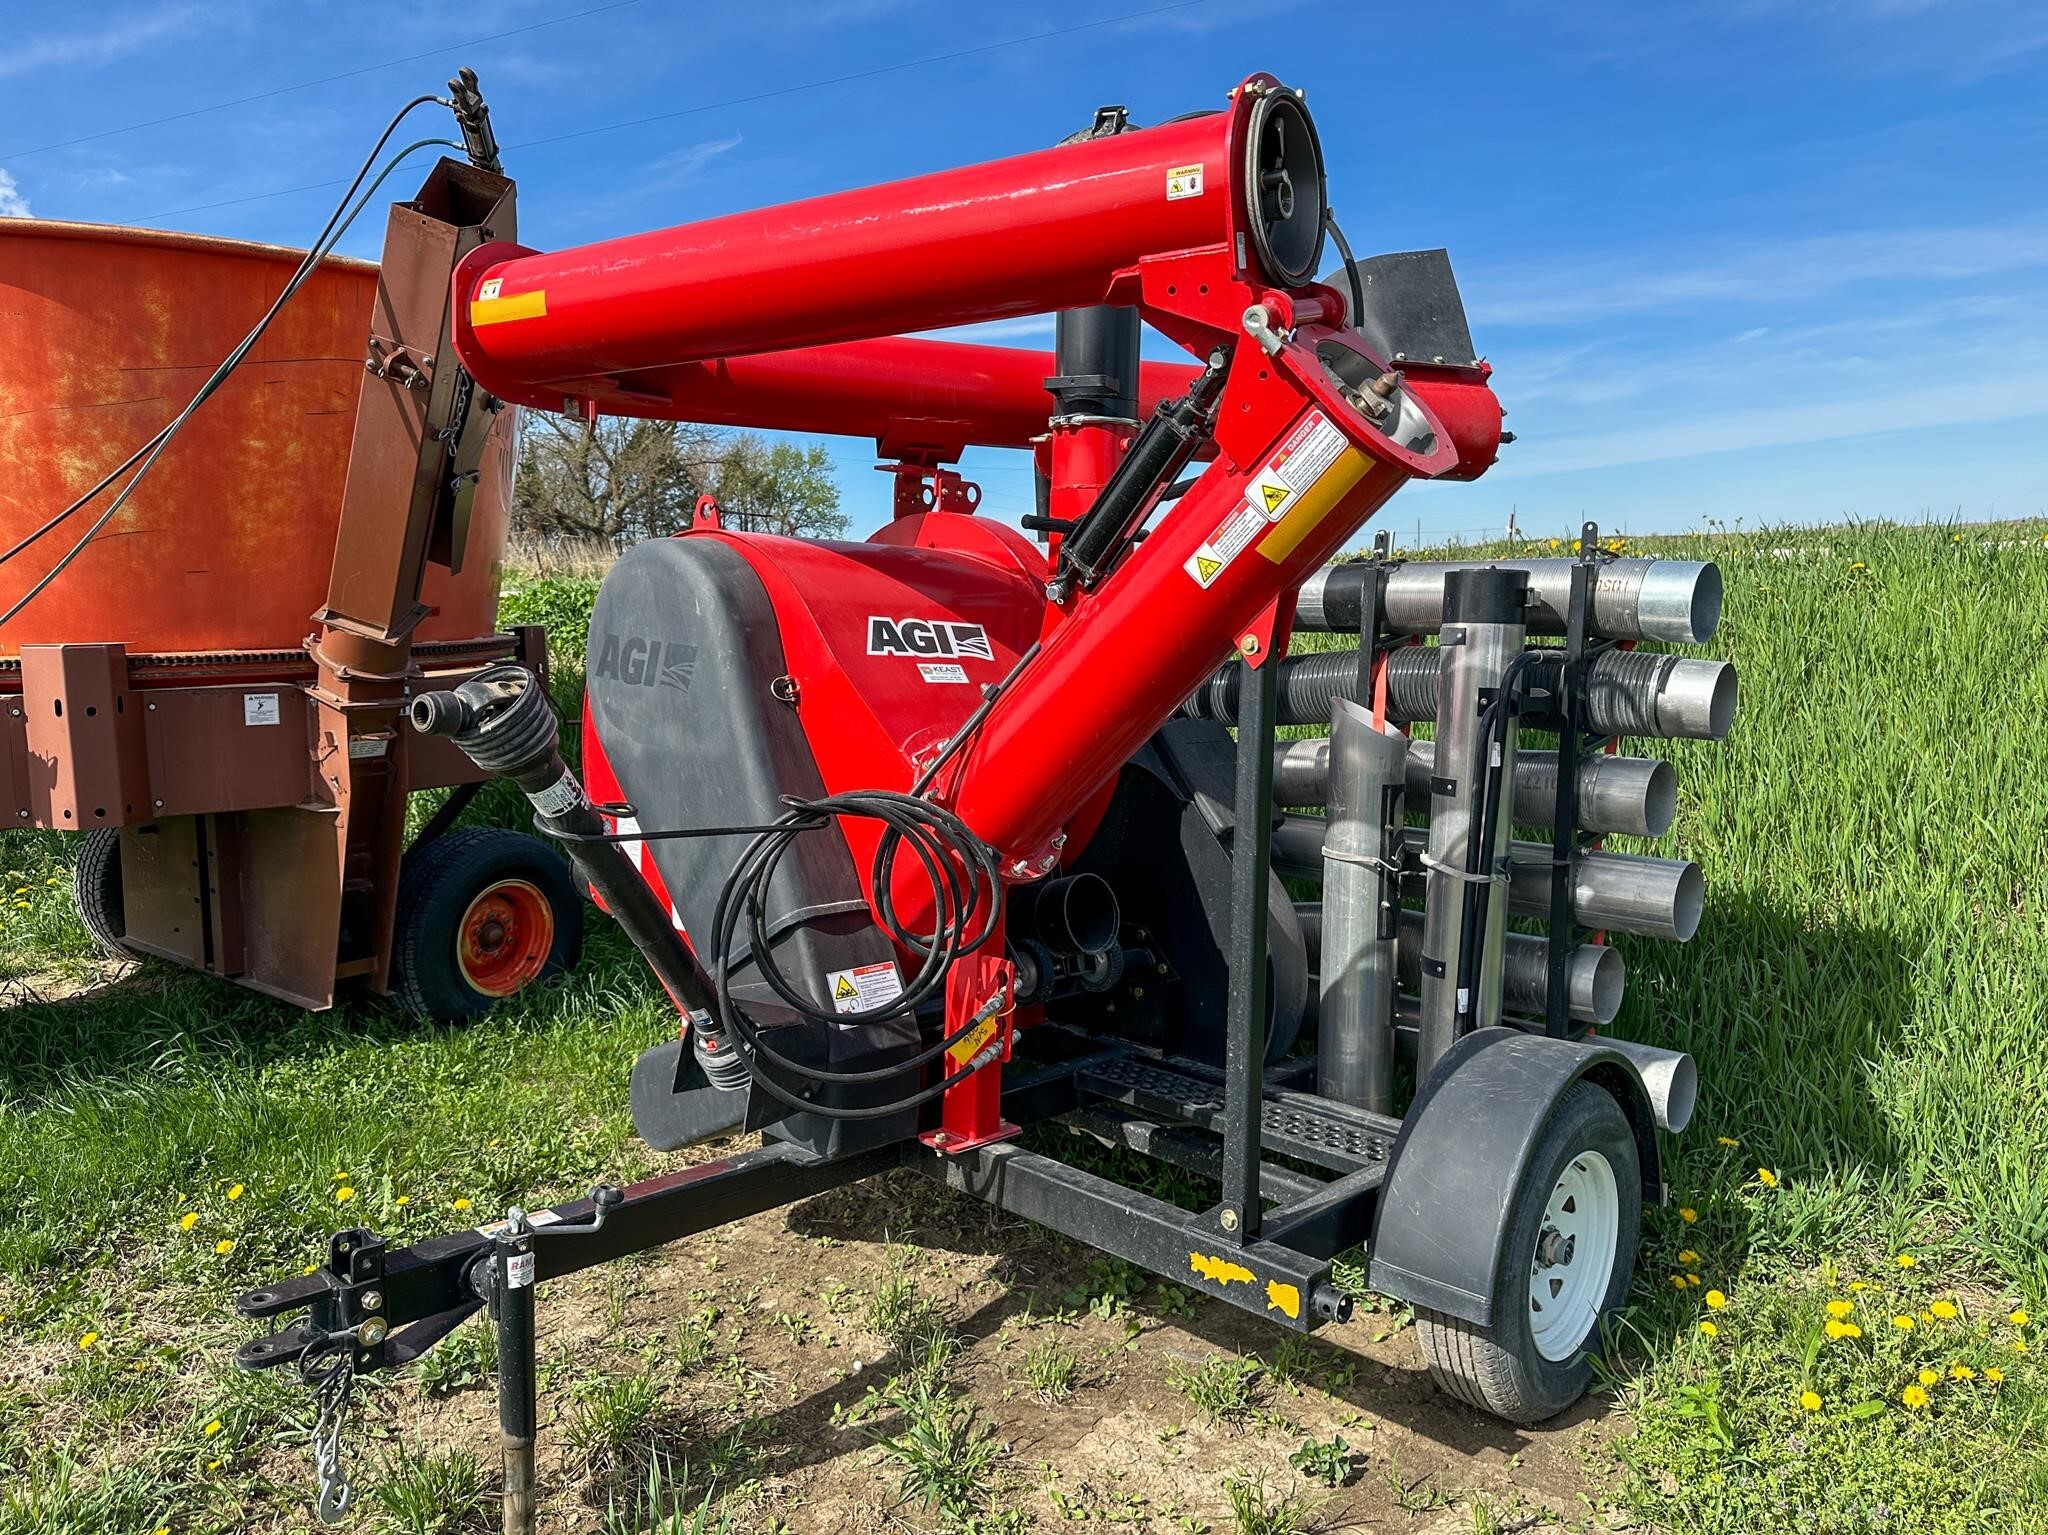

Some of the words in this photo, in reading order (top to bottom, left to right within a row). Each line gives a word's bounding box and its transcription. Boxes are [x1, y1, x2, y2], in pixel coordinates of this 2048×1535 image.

[1175, 167, 1201, 176] WARNING
[1287, 420, 1316, 452] DANGER
[871, 619, 955, 655] AGI
[595, 633, 662, 687] AGI
